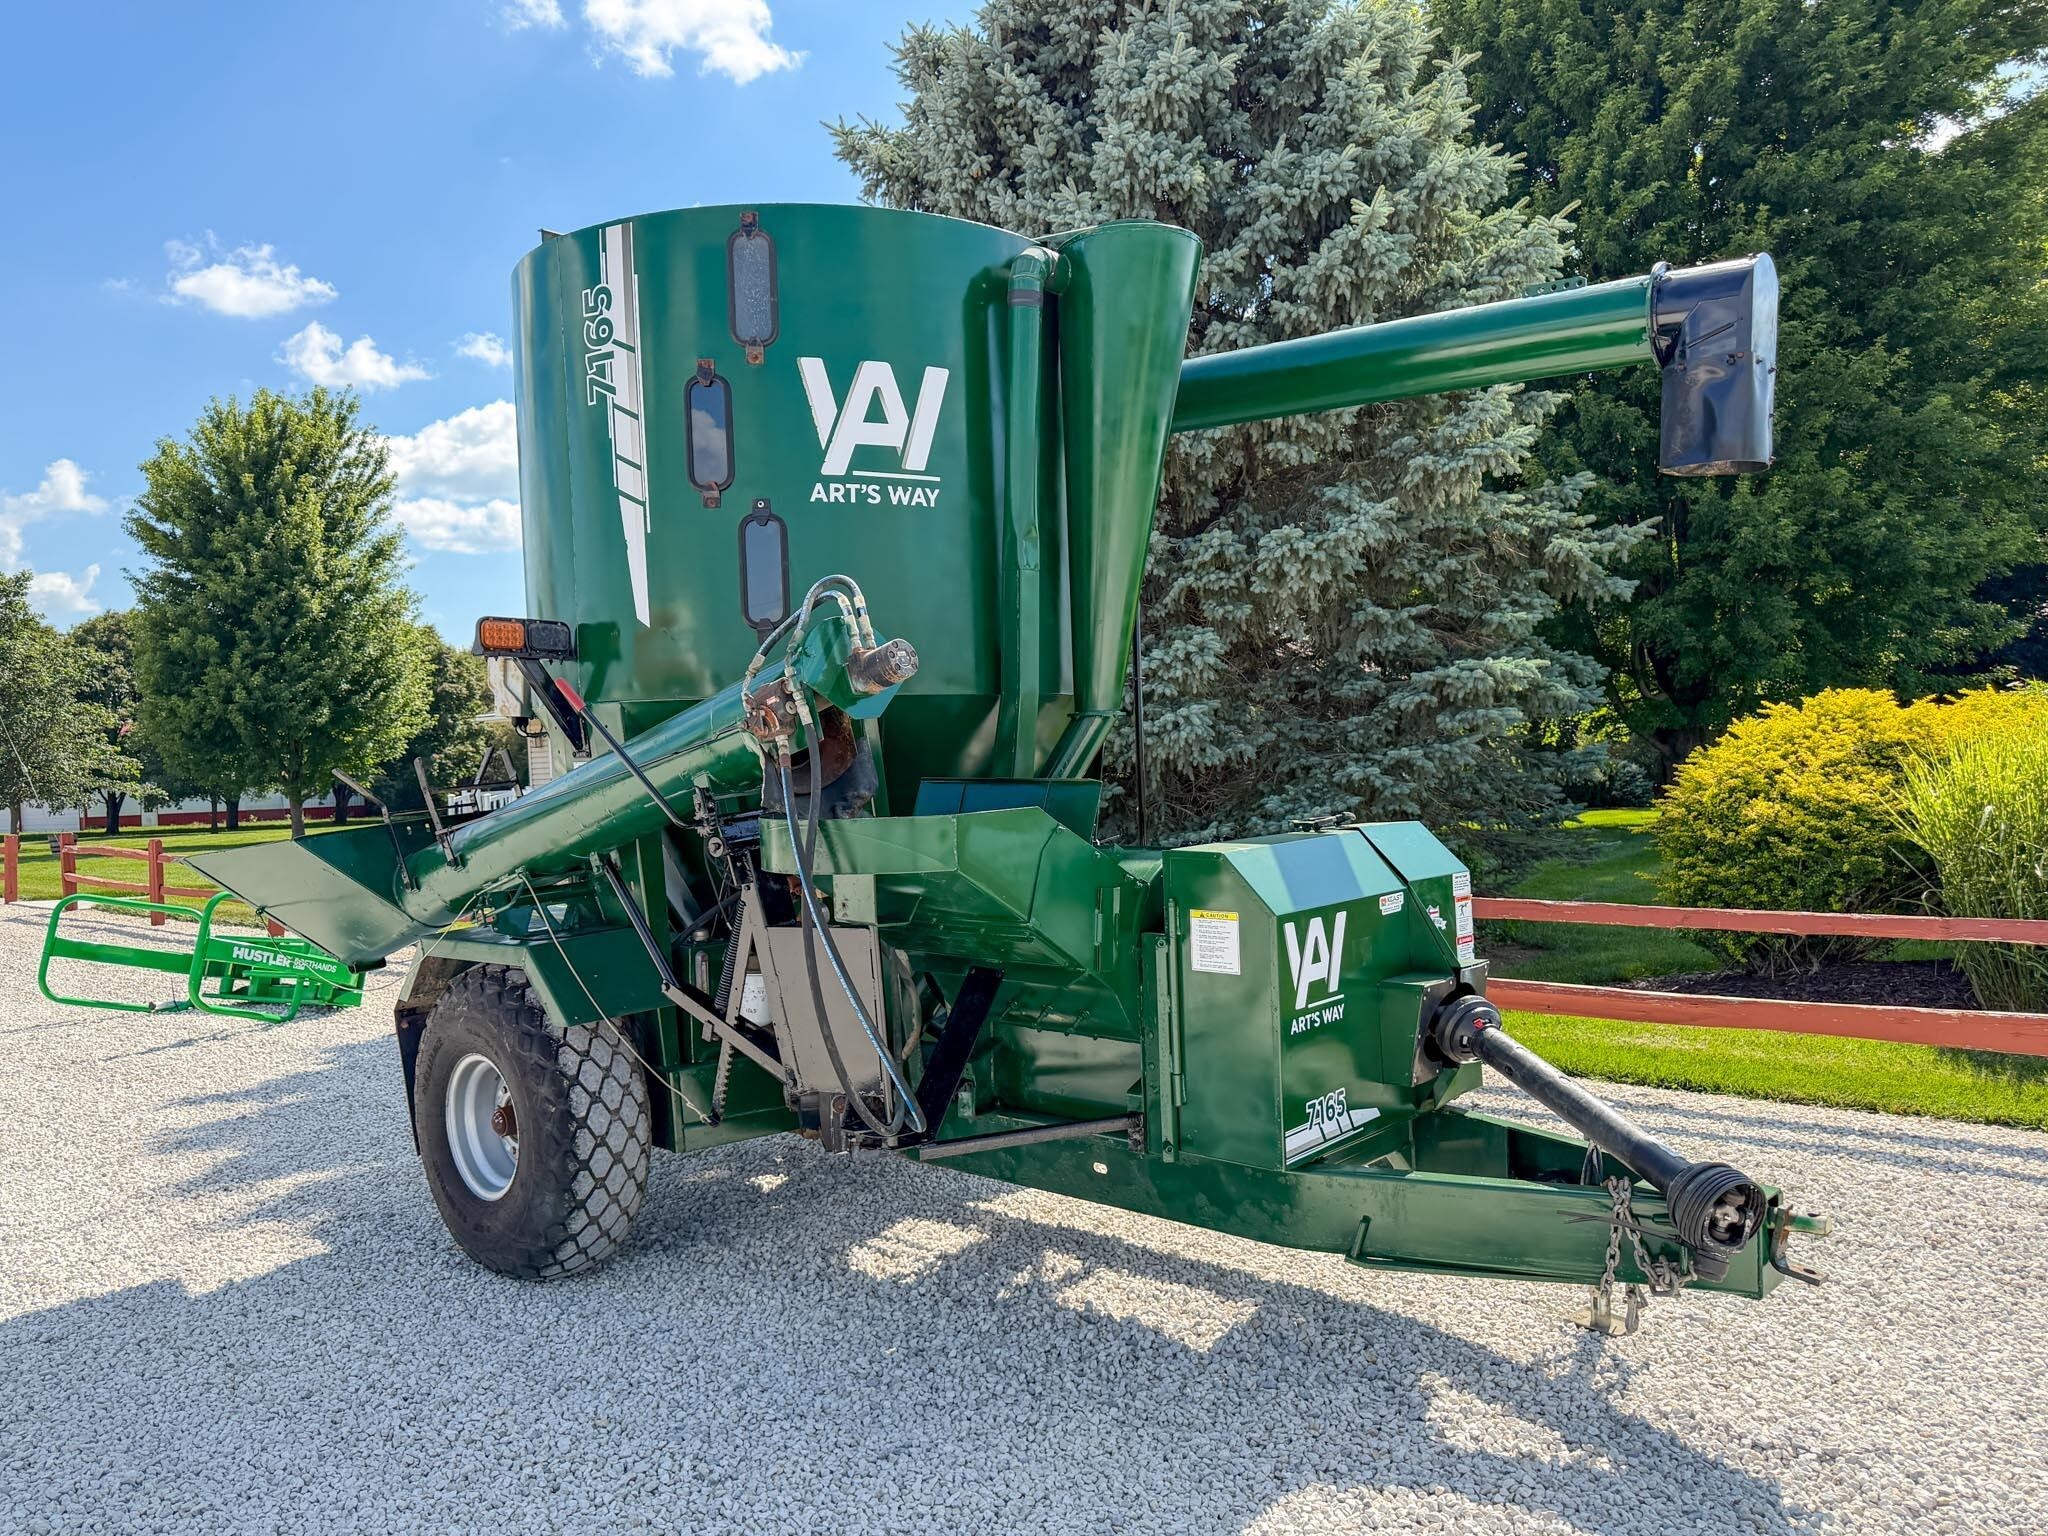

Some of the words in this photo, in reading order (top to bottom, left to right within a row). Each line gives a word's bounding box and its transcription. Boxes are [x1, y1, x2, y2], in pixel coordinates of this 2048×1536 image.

[582, 284, 616, 406] 7165
[809, 482, 882, 504] ART'S
[887, 485, 940, 508] WAY
[232, 946, 291, 968] HUSTLER
[1290, 1011, 1321, 1036] ART'S
[1322, 1003, 1345, 1025] WAY
[1305, 1087, 1347, 1131] 7165
